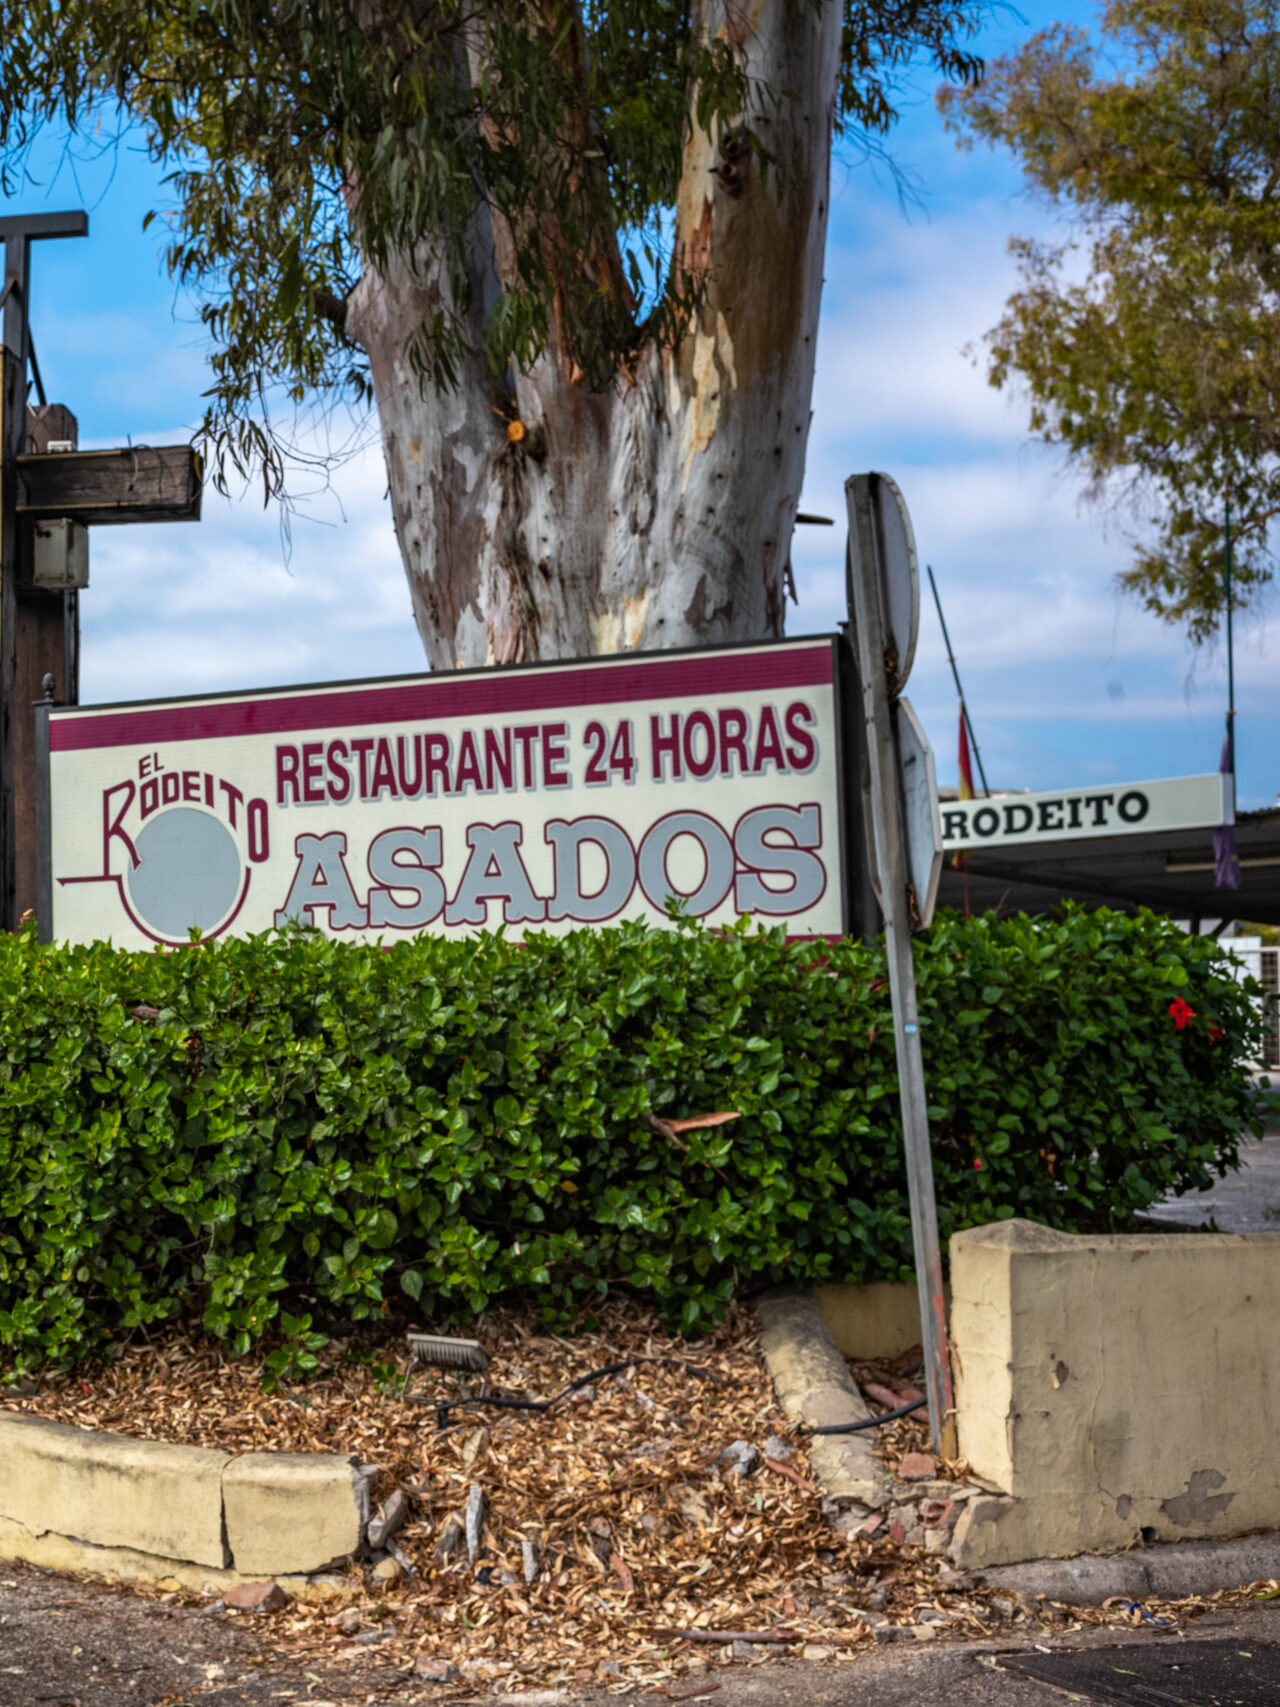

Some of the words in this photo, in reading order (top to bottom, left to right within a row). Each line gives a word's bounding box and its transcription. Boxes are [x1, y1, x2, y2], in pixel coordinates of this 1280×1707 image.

[138, 752, 164, 779] EL
[275, 721, 568, 804] RESTAURANTE
[582, 720, 634, 784] 24
[650, 701, 818, 780] HORAS
[103, 770, 270, 876] RODEITO
[273, 802, 826, 931] ASADOS
[941, 790, 1150, 841] RODEITO
